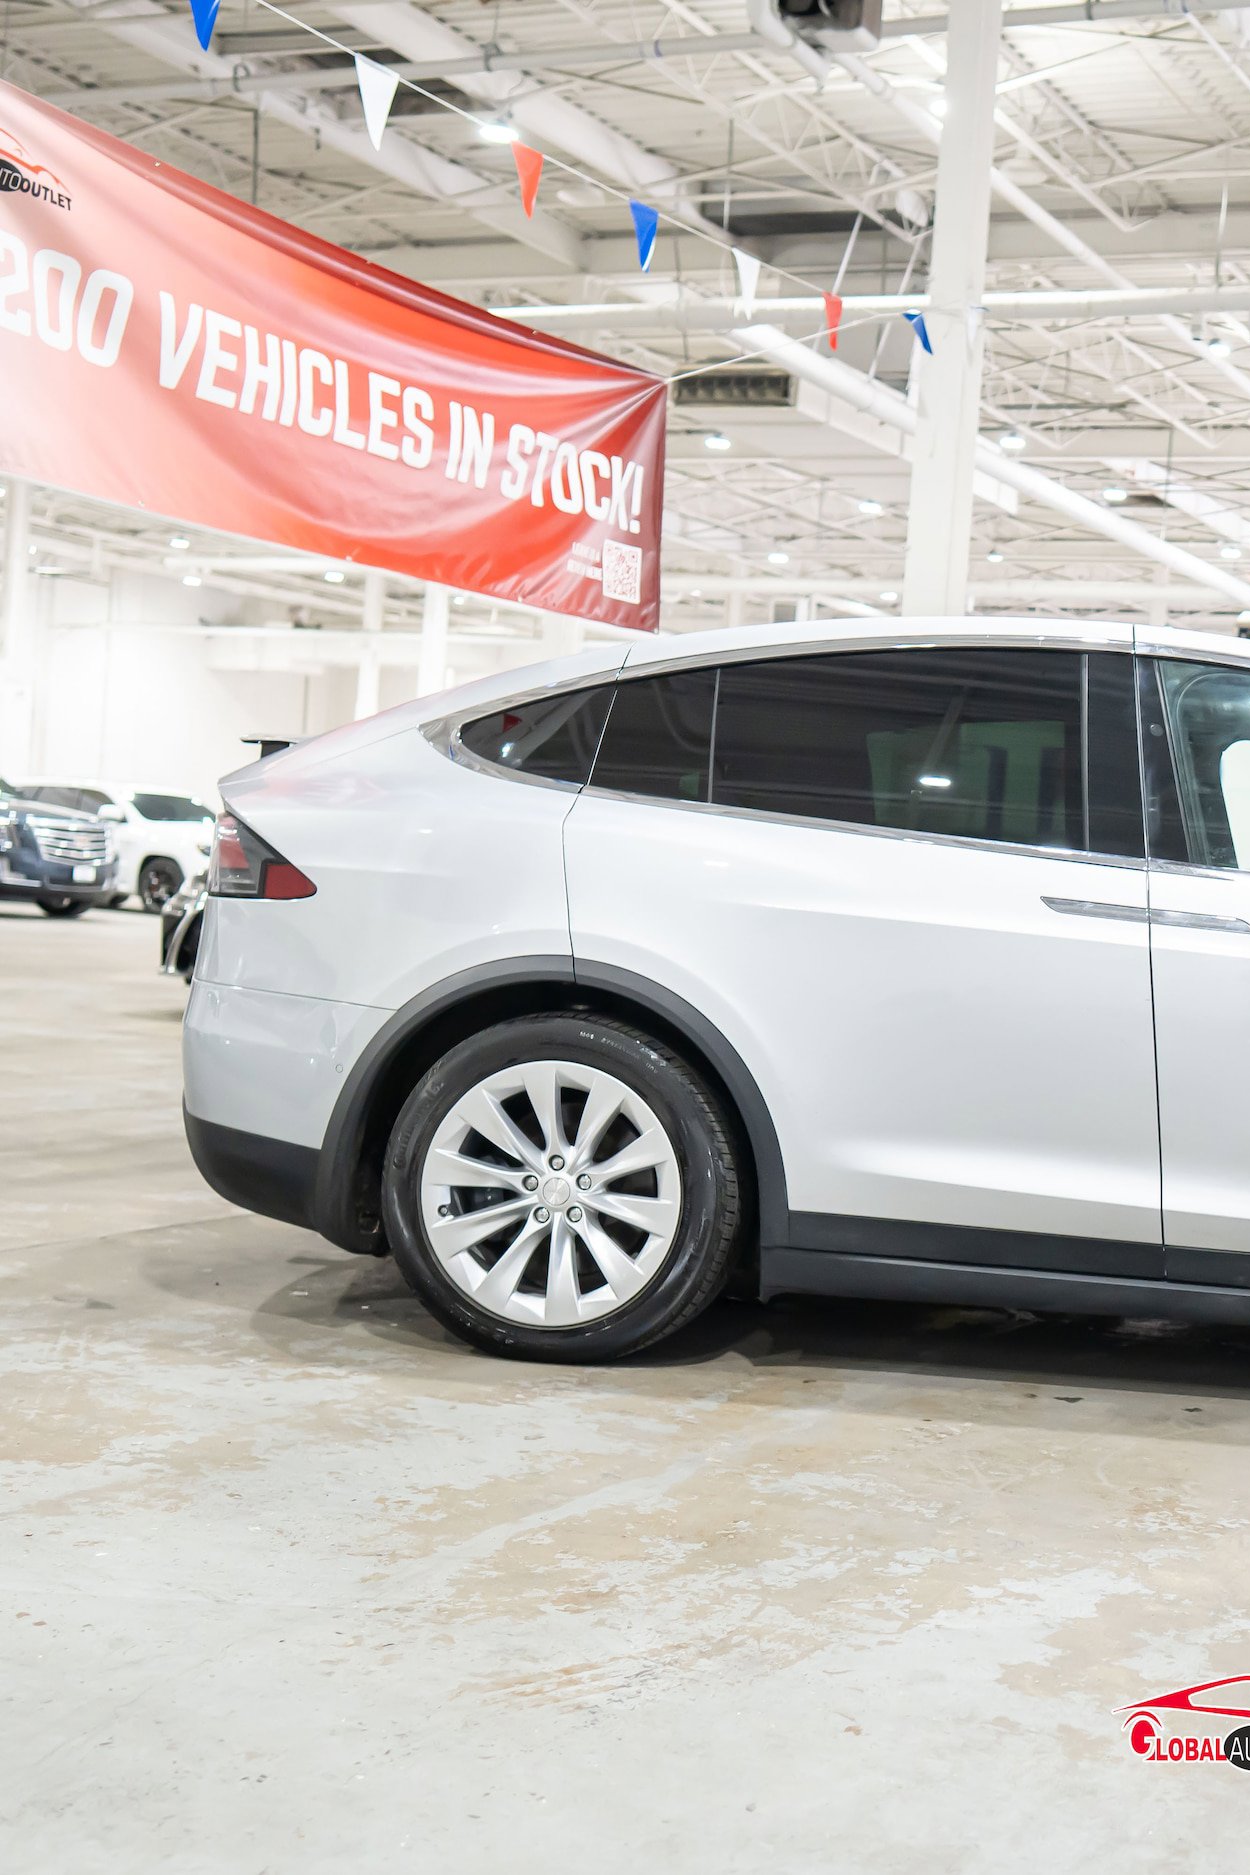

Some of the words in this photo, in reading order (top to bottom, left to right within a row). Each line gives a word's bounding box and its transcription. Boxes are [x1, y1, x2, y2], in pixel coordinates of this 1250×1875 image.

[20, 178, 72, 211] OUTLET
[158, 291, 434, 469] VEHICLES
[445, 401, 494, 489] IN
[500, 424, 644, 534] STOCK!
